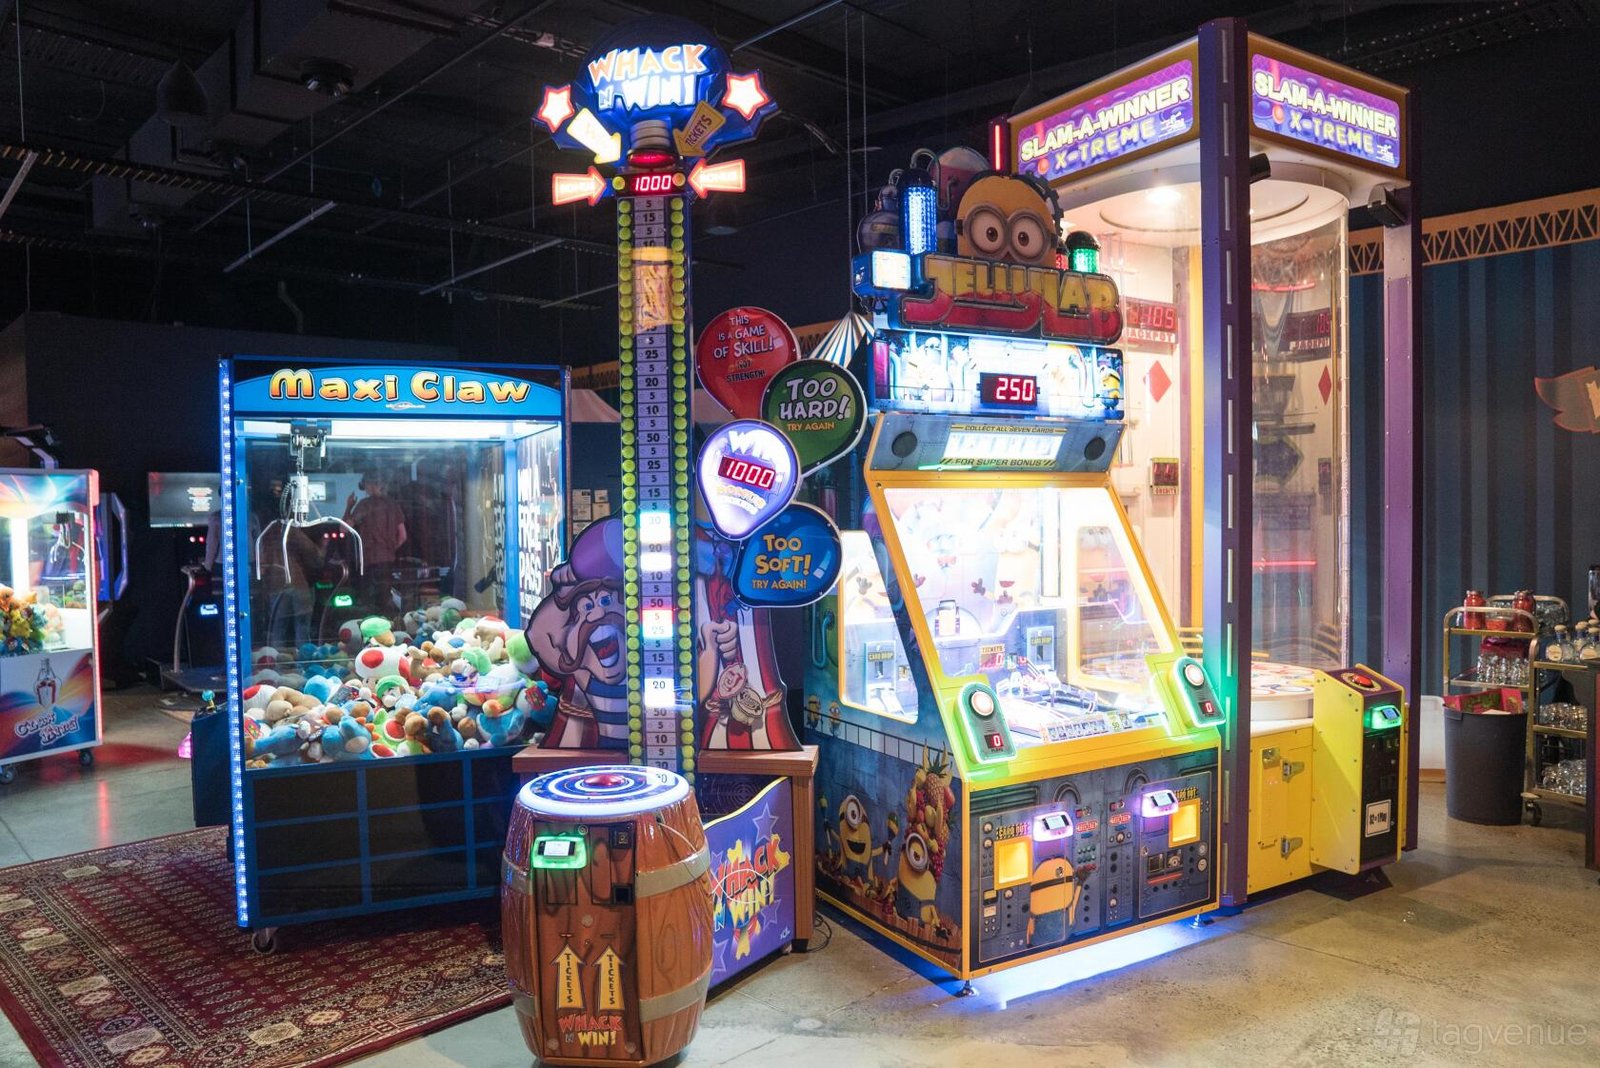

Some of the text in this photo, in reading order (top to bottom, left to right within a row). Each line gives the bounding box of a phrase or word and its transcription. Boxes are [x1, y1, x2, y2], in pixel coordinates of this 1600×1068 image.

[588, 44, 707, 87] WHACK
[1254, 72, 1398, 138] SLAM-A-WINNER
[1021, 78, 1190, 161] SLAM-A-WINNER
[686, 113, 713, 147] TICKETS
[1290, 110, 1374, 154] X-TREME
[1055, 117, 1156, 170] X-TREME
[635, 174, 672, 192] 1000
[646, 200, 652, 208] 5
[643, 213, 656, 222] 15
[646, 227, 652, 235] 5
[729, 315, 750, 326] THIS
[735, 324, 766, 339] GAME
[714, 336, 774, 358] OF SKILL!
[645, 350, 658, 359] 25
[649, 364, 655, 372] 5
[269, 368, 531, 404] Maxi Claw
[645, 378, 658, 387] 20
[786, 377, 837, 401] TOO
[996, 377, 1034, 401] 250
[649, 392, 655, 400] 5
[647, 406, 660, 414] 10
[779, 396, 850, 421] HARD!
[650, 419, 656, 427] 5
[787, 422, 835, 432] TRY AGAIN
[647, 433, 660, 442] 50
[650, 447, 656, 455] 5
[647, 460, 661, 469] 25
[726, 460, 774, 488] 1000
[648, 488, 660, 498] 15
[650, 572, 662, 580] 10
[654, 585, 660, 593] 5
[752, 578, 807, 590] TRY AGAIN!
[656, 640, 661, 648] 5
[652, 654, 664, 662] 15
[658, 721, 664, 730] 5
[655, 735, 668, 744] 10
[658, 748, 664, 756] 5
[564, 953, 573, 1003] TICKETS
[606, 954, 615, 1005] TICKETS
[558, 1013, 622, 1033] WHACK
[578, 1030, 617, 1047] WIN!
